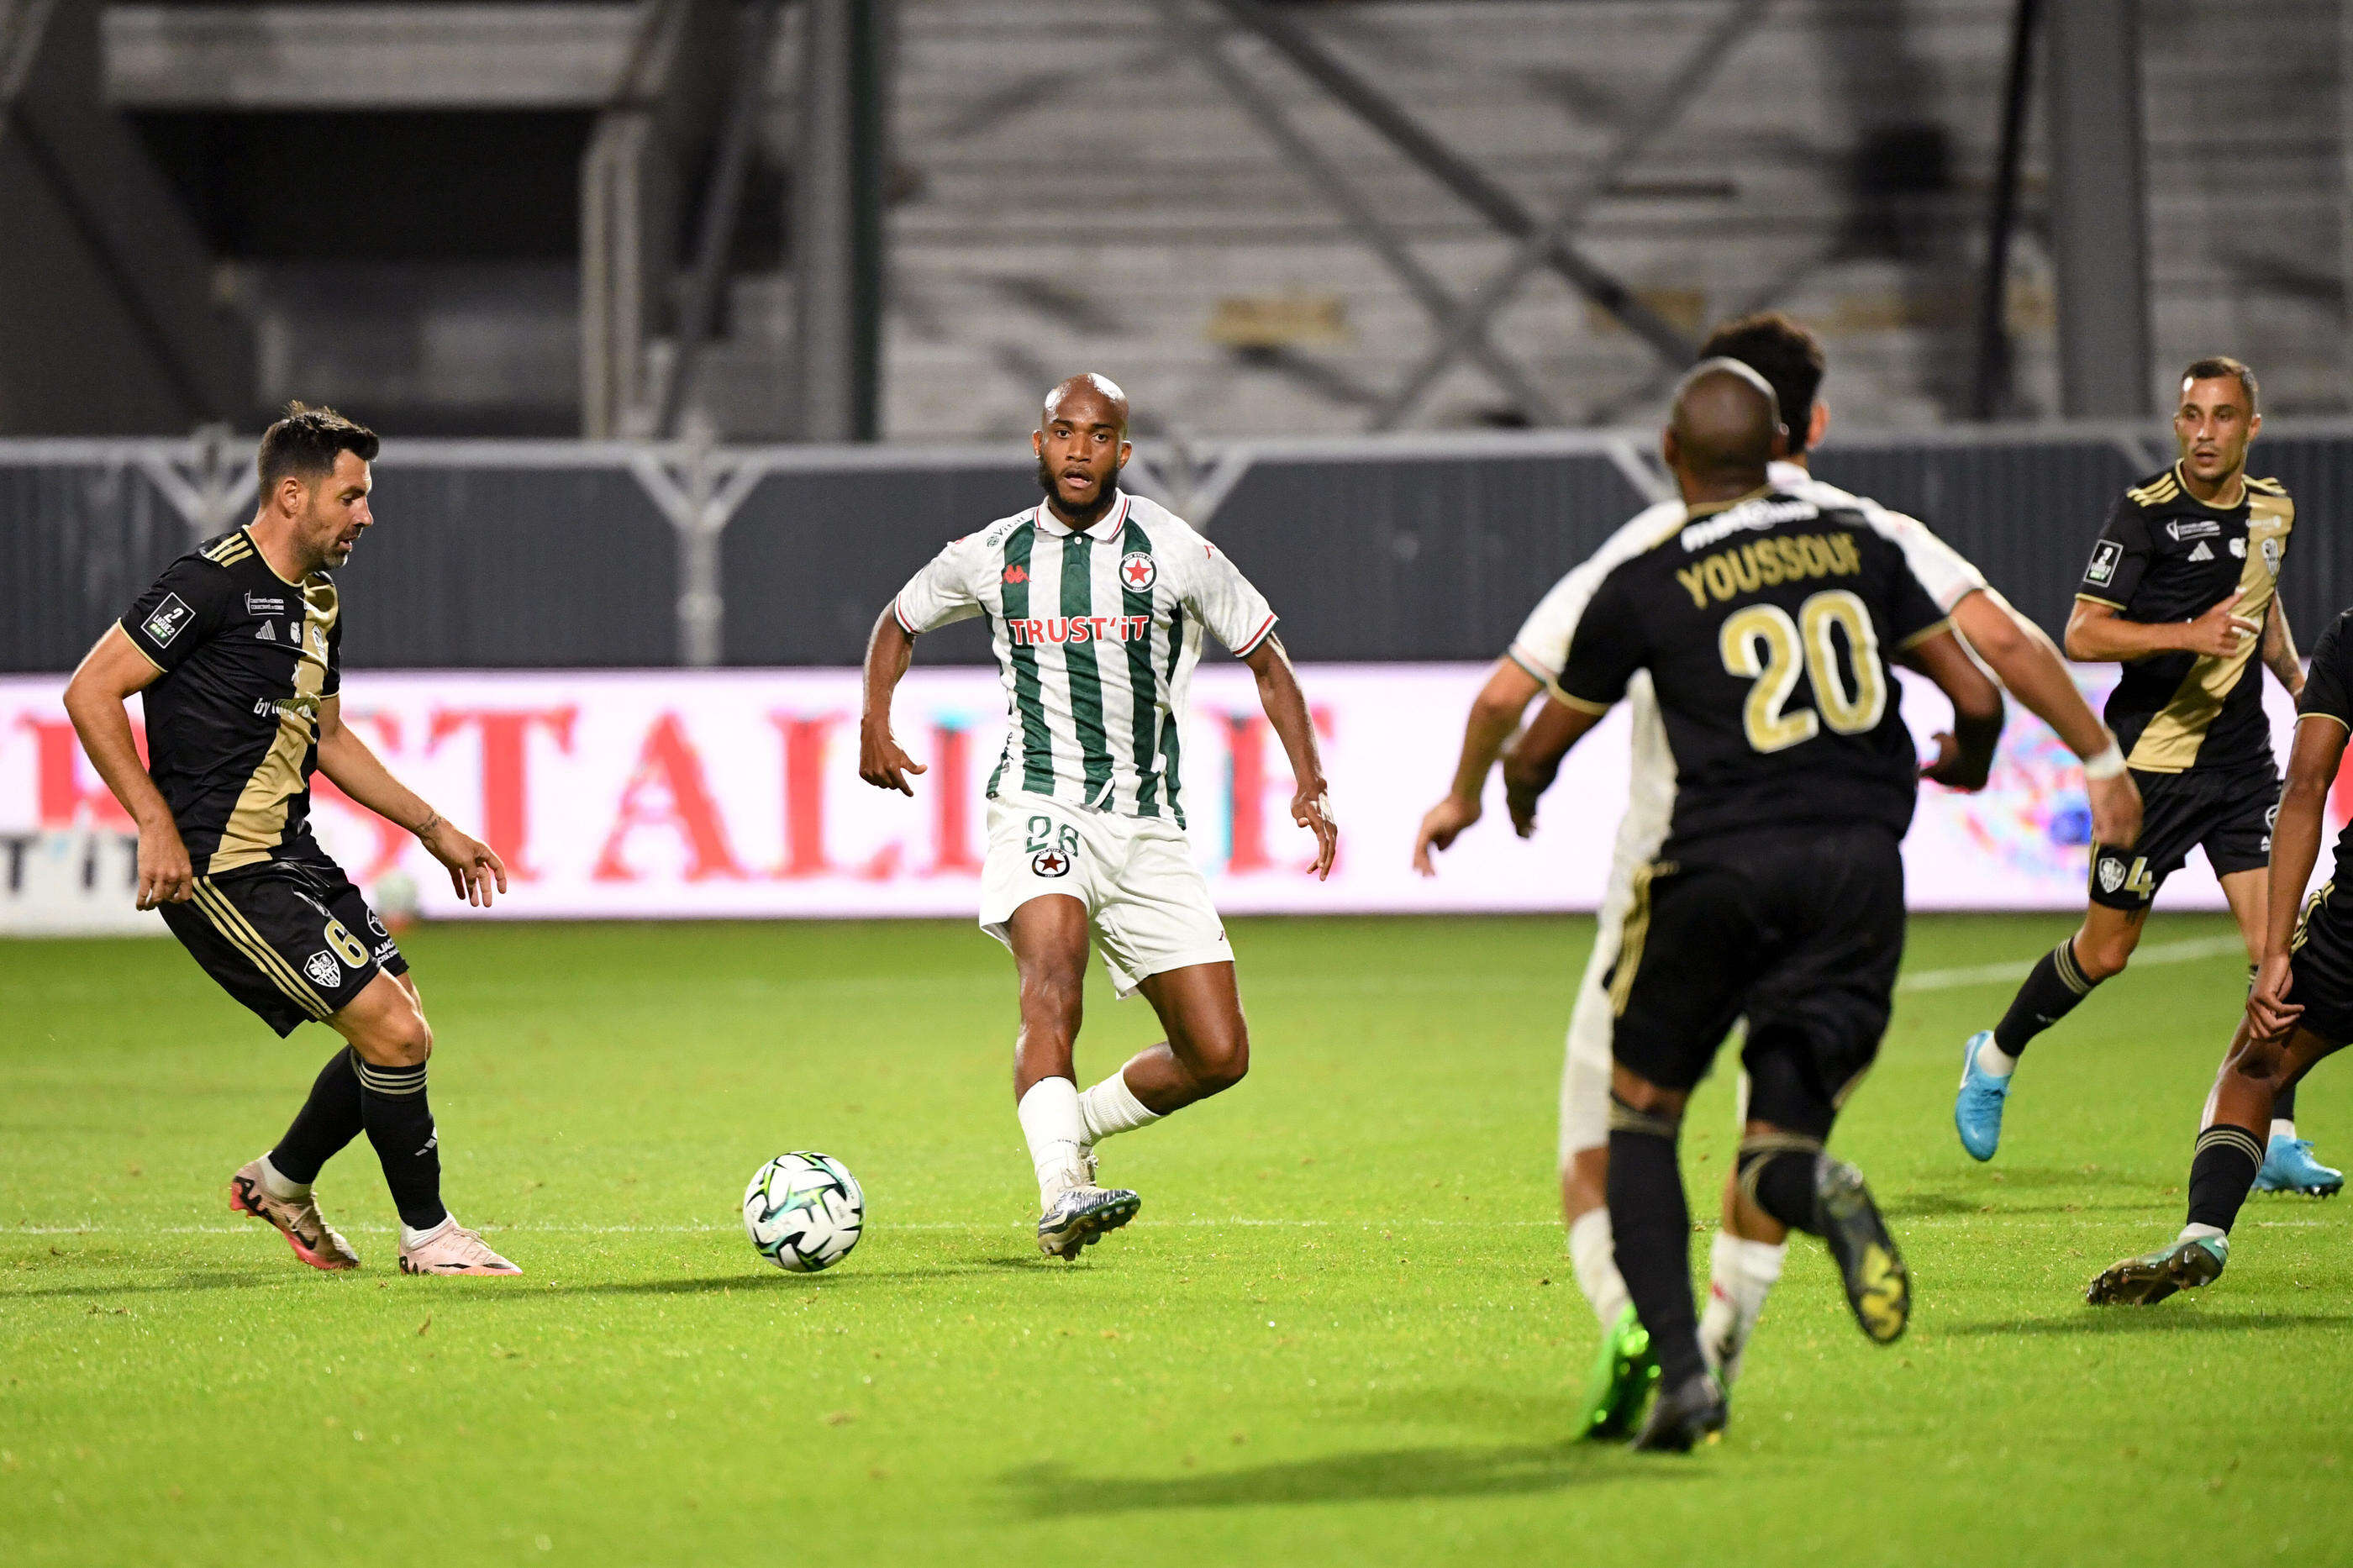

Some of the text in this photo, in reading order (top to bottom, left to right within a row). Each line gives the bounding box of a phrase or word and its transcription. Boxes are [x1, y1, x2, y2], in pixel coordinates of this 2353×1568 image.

[1677, 532, 1861, 610] YOUSSOUF
[163, 607, 184, 624] 2
[1718, 588, 1888, 754] 20
[254, 697, 271, 718] by
[2124, 855, 2156, 901] 4
[324, 919, 370, 969] 6
